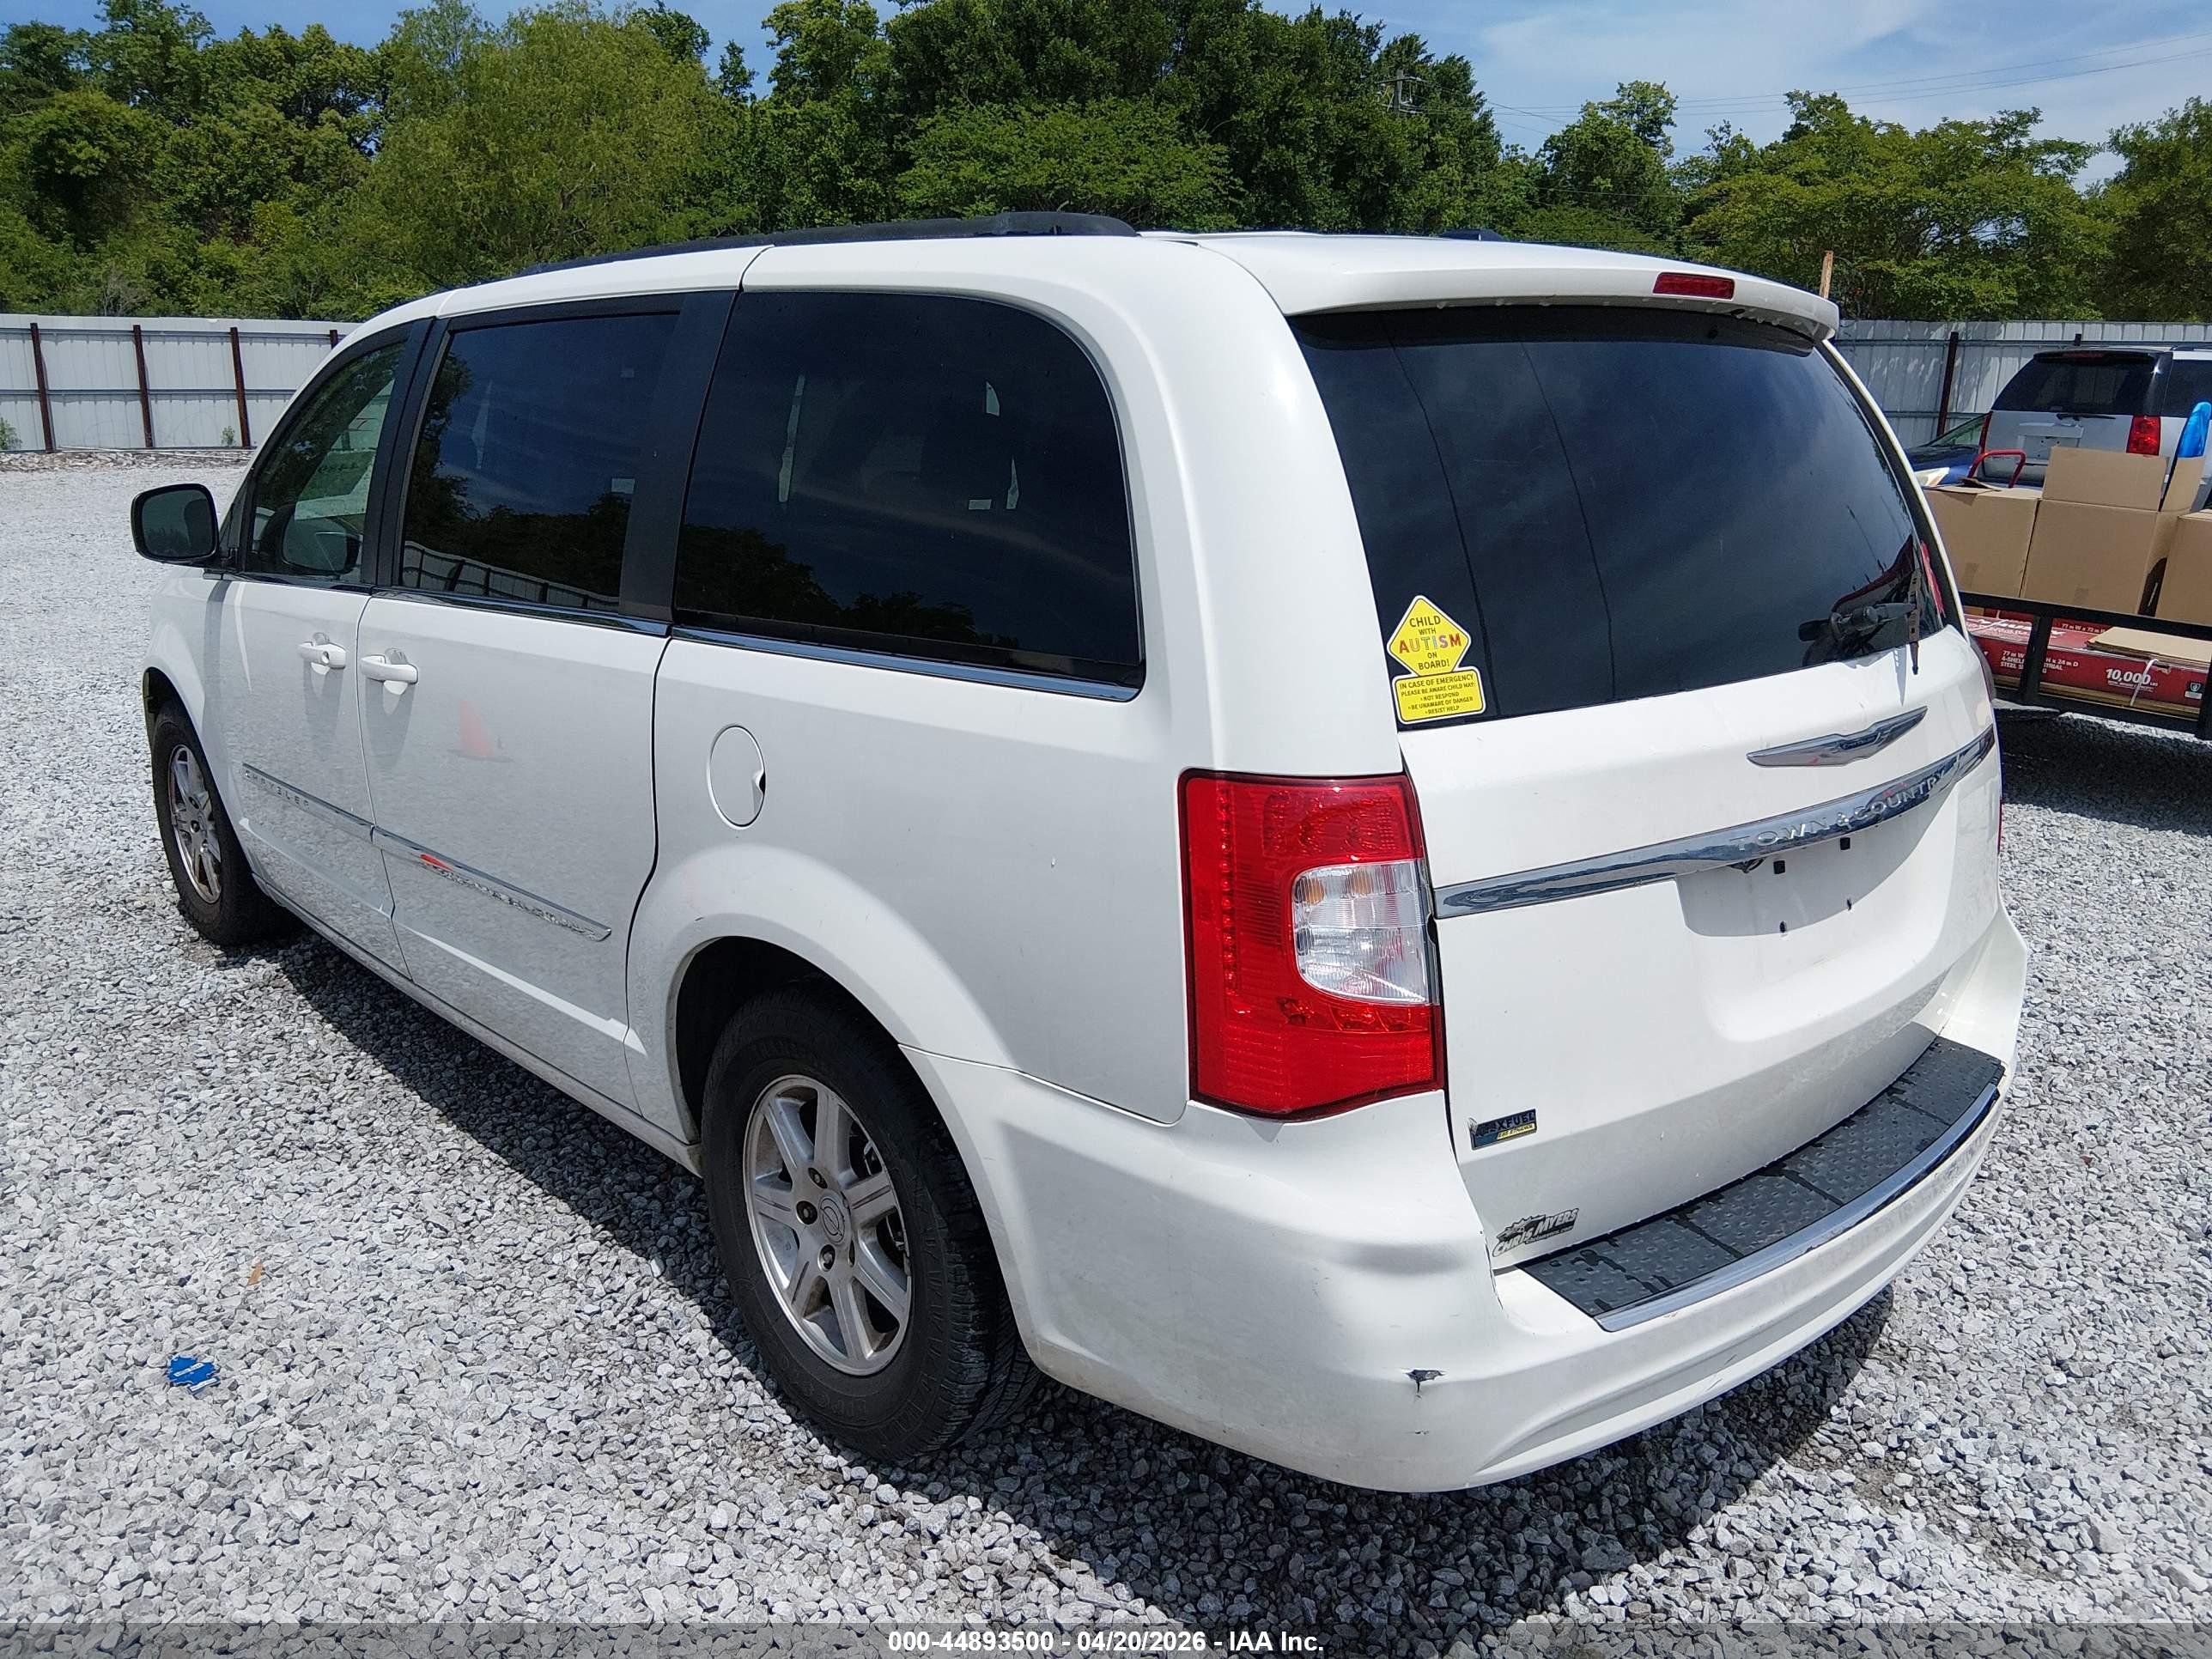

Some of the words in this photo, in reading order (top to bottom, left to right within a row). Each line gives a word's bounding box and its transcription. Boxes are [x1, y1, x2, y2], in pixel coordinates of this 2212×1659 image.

[1409, 615, 1441, 628] CHILD
[1399, 632, 1462, 654] AUTISM
[1418, 658, 1450, 671] BOARD!
[1408, 680, 1425, 689] CASE
[1436, 673, 1474, 685] EMERGENCY
[2106, 668, 2151, 685] 10,000
[1401, 689, 1421, 697] PLEASE
[1435, 691, 1460, 700] RESPOND
[1452, 696, 1474, 704] DANGER
[1729, 817, 1831, 851] TOWN
[1853, 769, 1946, 821] COUNTRY
[1492, 1226, 1535, 1258] CHRIS
[1532, 1207, 1580, 1237] MYERS
